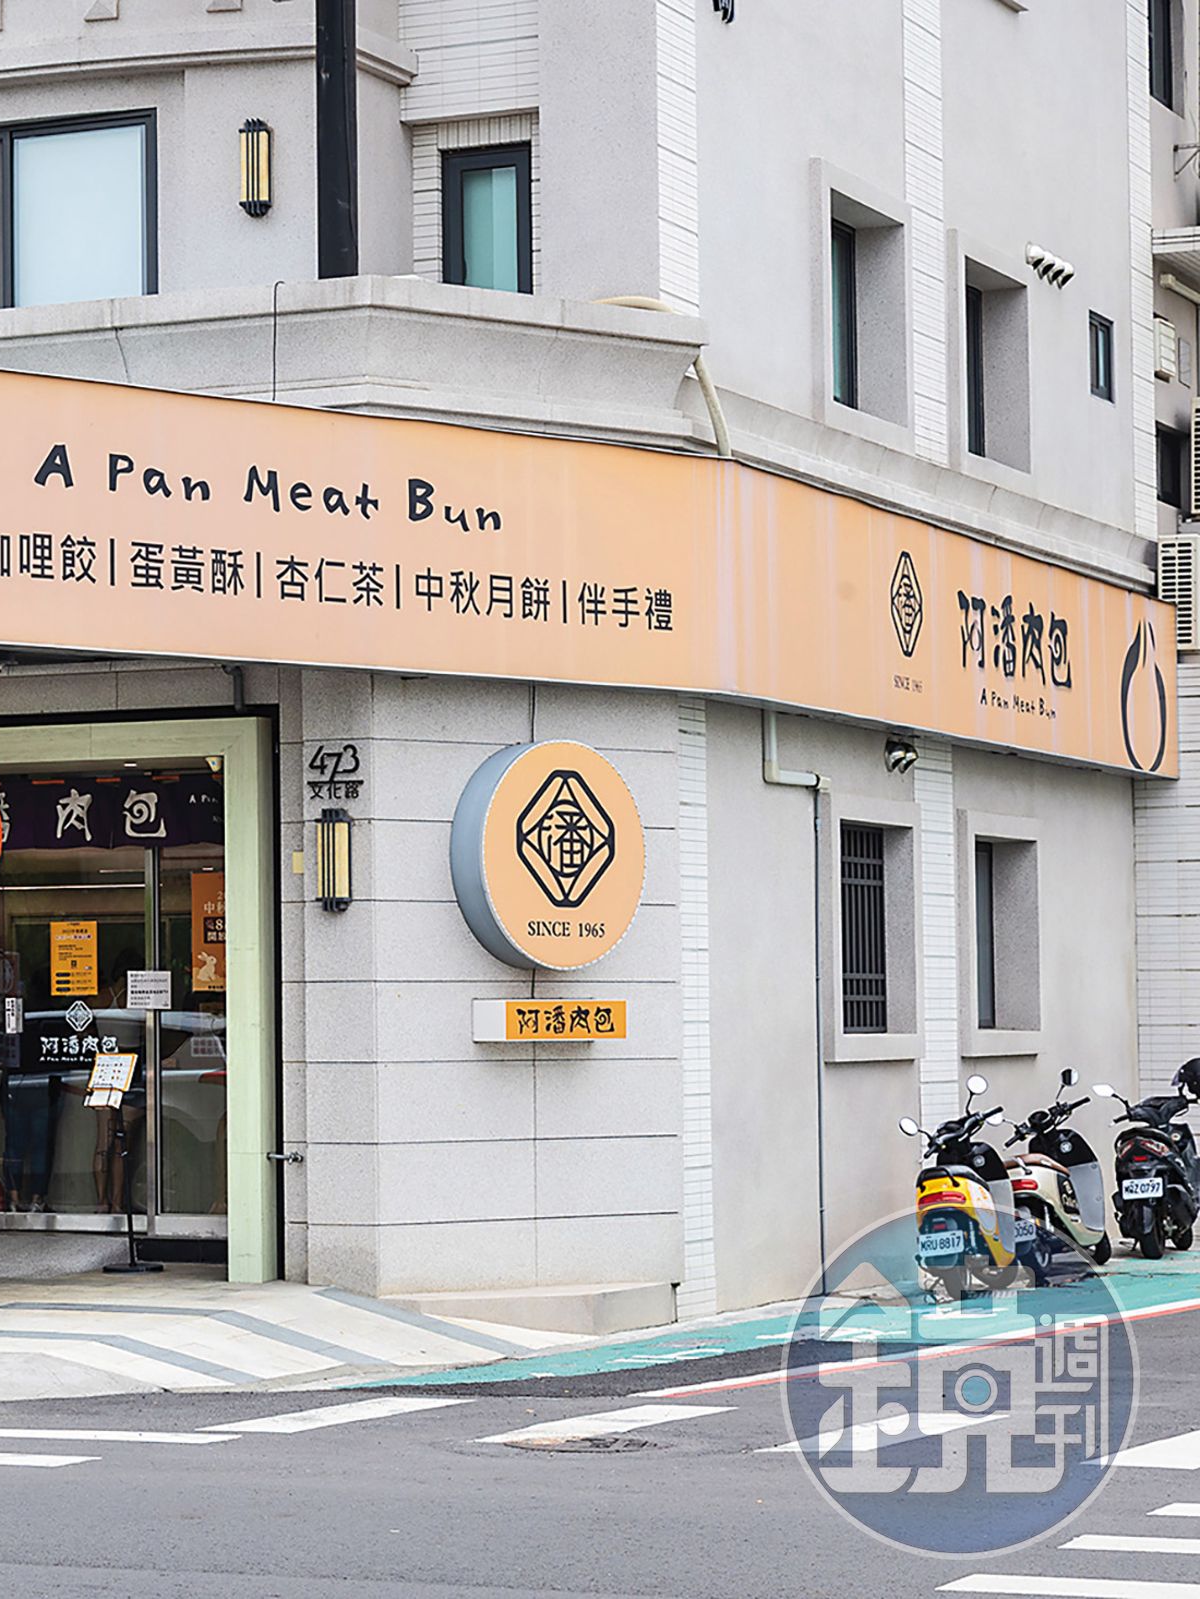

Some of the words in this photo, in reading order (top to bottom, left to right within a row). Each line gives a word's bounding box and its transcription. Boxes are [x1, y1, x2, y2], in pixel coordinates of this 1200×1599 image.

[34, 444, 74, 488] A
[109, 453, 211, 501] Pan
[244, 465, 379, 519] Meat
[408, 478, 502, 532] Bun
[957, 590, 1072, 689] 阿潘肉包
[980, 688, 987, 705] A
[991, 691, 1009, 709] Pan
[308, 744, 360, 782] 473
[527, 921, 571, 937] SINCE
[578, 922, 605, 939] 1965
[516, 1005, 614, 1035] 阿潘肉包
[40, 1035, 119, 1054] 阿潘肉包
